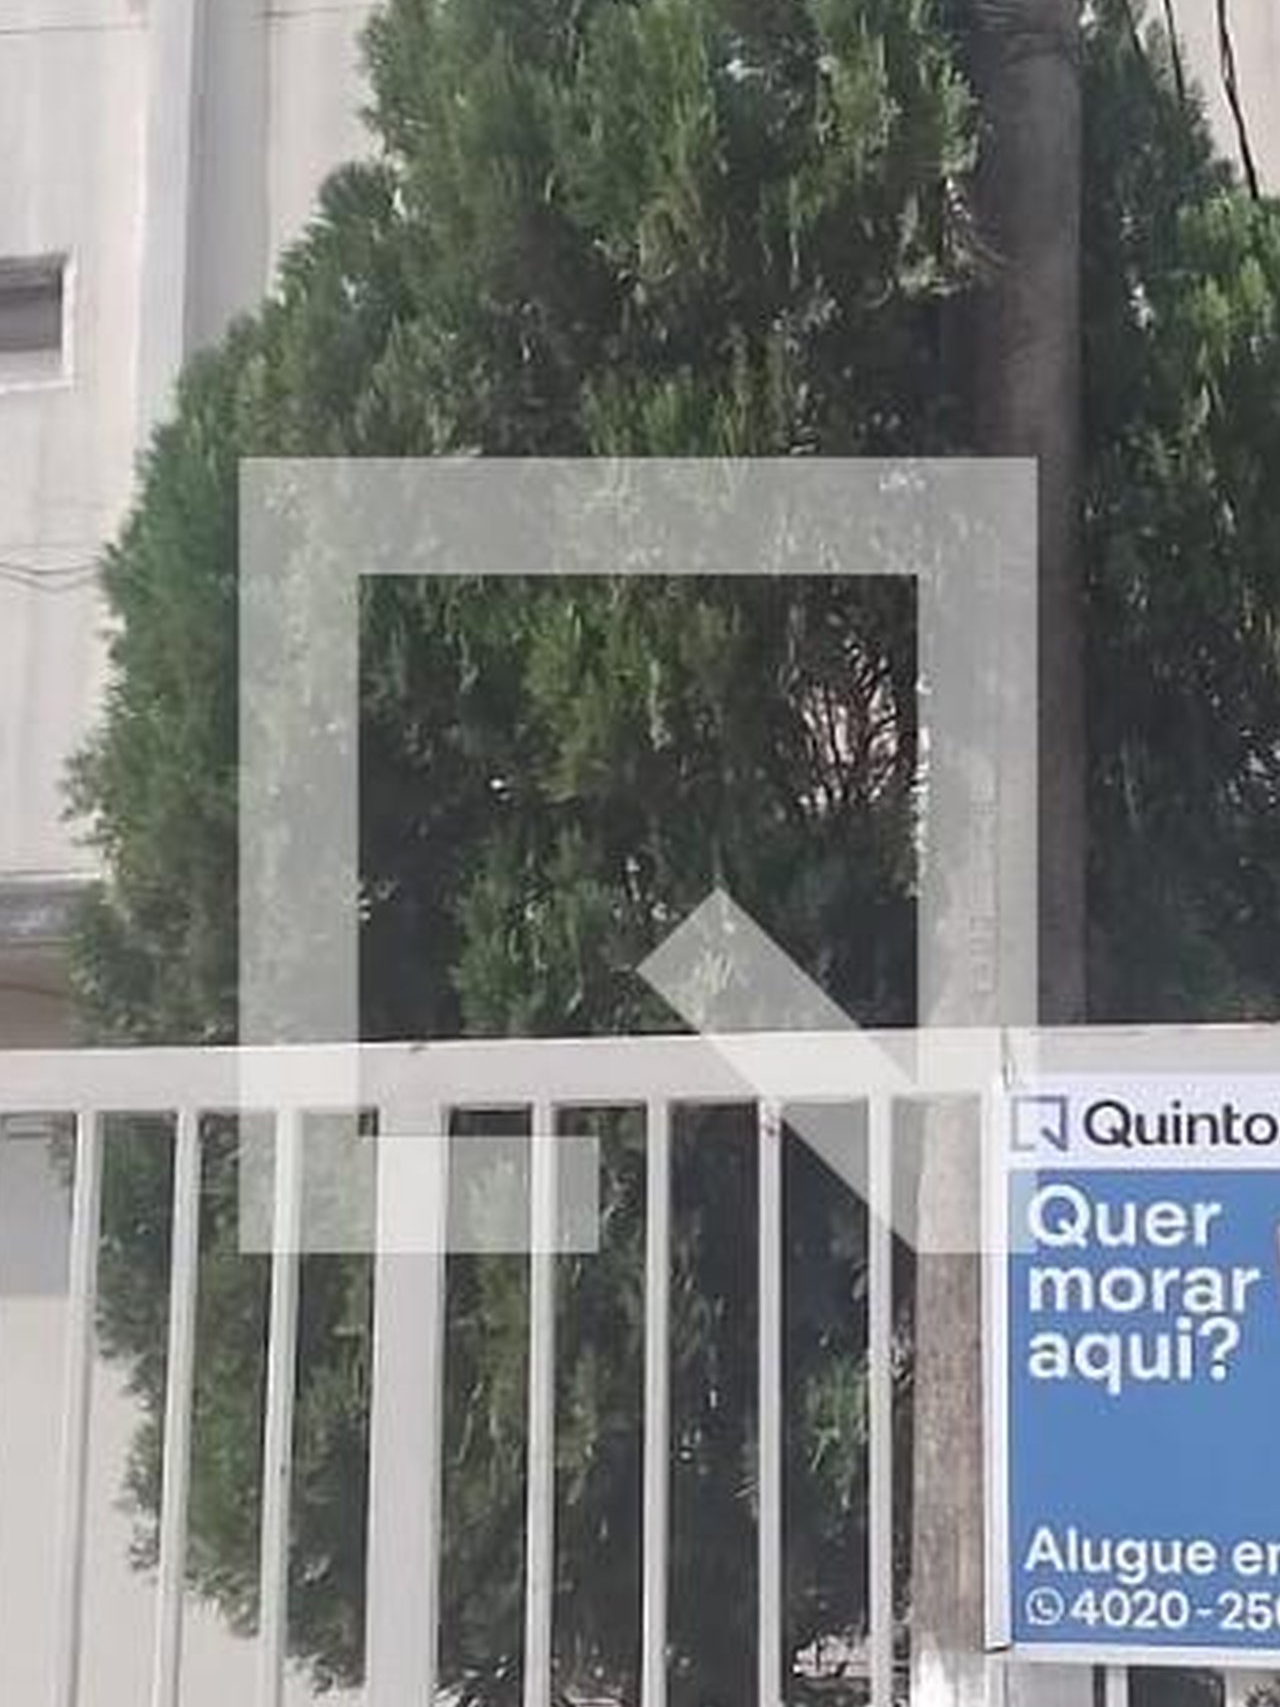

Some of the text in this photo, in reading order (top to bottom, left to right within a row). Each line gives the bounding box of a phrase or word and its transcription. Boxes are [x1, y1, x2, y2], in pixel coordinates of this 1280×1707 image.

[1028, 1183, 1222, 1248] Quer
[1028, 1265, 1261, 1313] morar
[1028, 1315, 1241, 1395] aqui?
[1023, 1525, 1218, 1584] Alugue
